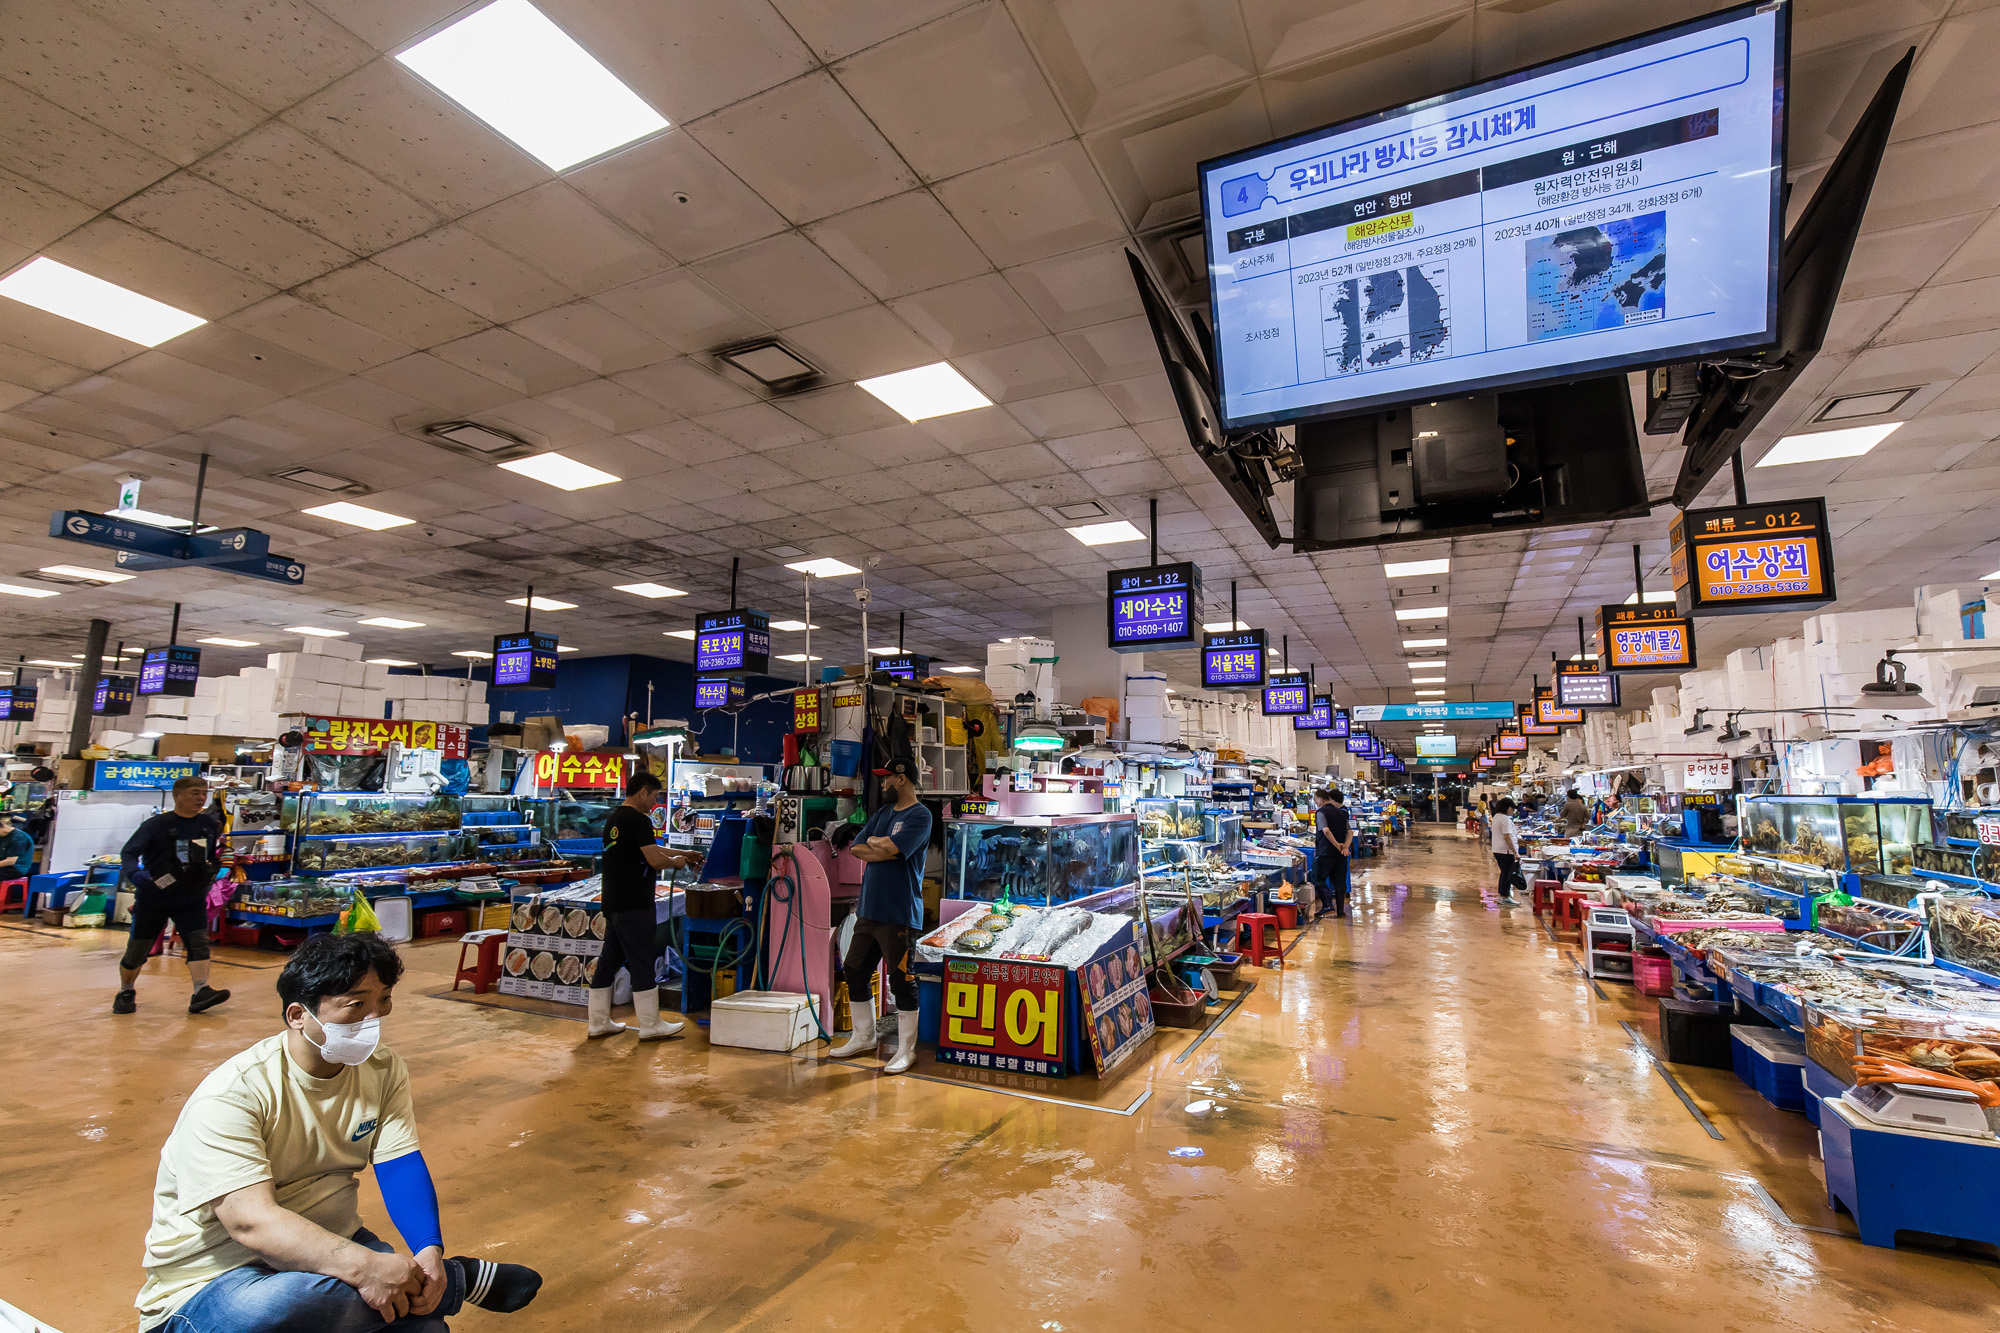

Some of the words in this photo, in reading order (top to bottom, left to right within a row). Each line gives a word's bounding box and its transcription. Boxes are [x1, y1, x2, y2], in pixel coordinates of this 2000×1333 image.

[1290, 151, 1370, 191] 우리나라
[1375, 137, 1438, 169] 방사능
[1445, 104, 1537, 151] 감시체계
[1561, 150, 1576, 166] 원
[1589, 139, 1617, 160] 근해
[1533, 158, 1643, 196] 원자력안전위원회
[1237, 187, 1249, 204] 4
[1537, 190, 1580, 208] (해양환경
[1582, 182, 1612, 198] 방사능
[1614, 175, 1639, 191] 감시)
[1353, 200, 1377, 218] 연안
[1388, 191, 1413, 209] 항만
[1494, 223, 1532, 242] 2023년
[1534, 216, 1560, 232] 40개
[1563, 208, 1606, 228] (일반정점
[1608, 200, 1634, 216] 34개,
[1637, 191, 1679, 211] 강화정점
[1681, 186, 1703, 201] 6개)
[1354, 214, 1413, 237] 해양수산부
[1244, 228, 1266, 244] 구분
[1343, 224, 1425, 253] (해양방사성물질조사)
[1238, 254, 1276, 270] 조사주체
[1297, 270, 1329, 286] 2023년
[1331, 263, 1353, 277] 52개
[1355, 255, 1391, 274] (일반정점
[1393, 249, 1414, 267] 23개,
[1416, 242, 1451, 259] 주요정점
[1453, 236, 1478, 252] 29개)
[1245, 327, 1281, 343] 조사정점
[1705, 517, 1736, 532] 패류
[1765, 512, 1801, 528] 012
[1707, 543, 1809, 581] 여수상회
[1157, 573, 1179, 585] 132
[1710, 581, 1810, 596] 010-2258-5362
[1119, 595, 1183, 619] 세아수산
[1616, 611, 1636, 621] 패류
[1653, 609, 1676, 619] 011
[727, 616, 741, 626] 115
[1118, 622, 1184, 637] 010-8609-1407
[701, 636, 741, 654] 목포상회
[1238, 636, 1254, 644] 131
[1616, 629, 1682, 653] 영광해물2
[700, 656, 741, 668] 010-2360-2258
[1210, 653, 1256, 672] 서울전복
[699, 685, 726, 699] 여수수산
[795, 693, 818, 709] 목포
[795, 712, 818, 729] 상회
[104, 766, 193, 779] 금성(나주)상회
[538, 754, 623, 784] 여수수산
[1687, 762, 1730, 777] 문어전문
[961, 802, 986, 814] 아수산
[982, 963, 1009, 981] 여름철
[1011, 966, 1029, 984] 인기
[1031, 968, 1060, 987] 보양식
[946, 982, 1058, 1055] 민어
[955, 1051, 990, 1066] 부위별
[995, 1056, 1018, 1070] 분할
[1024, 1060, 1047, 1073] 판매
[357, 1118, 378, 1133] NIKE
